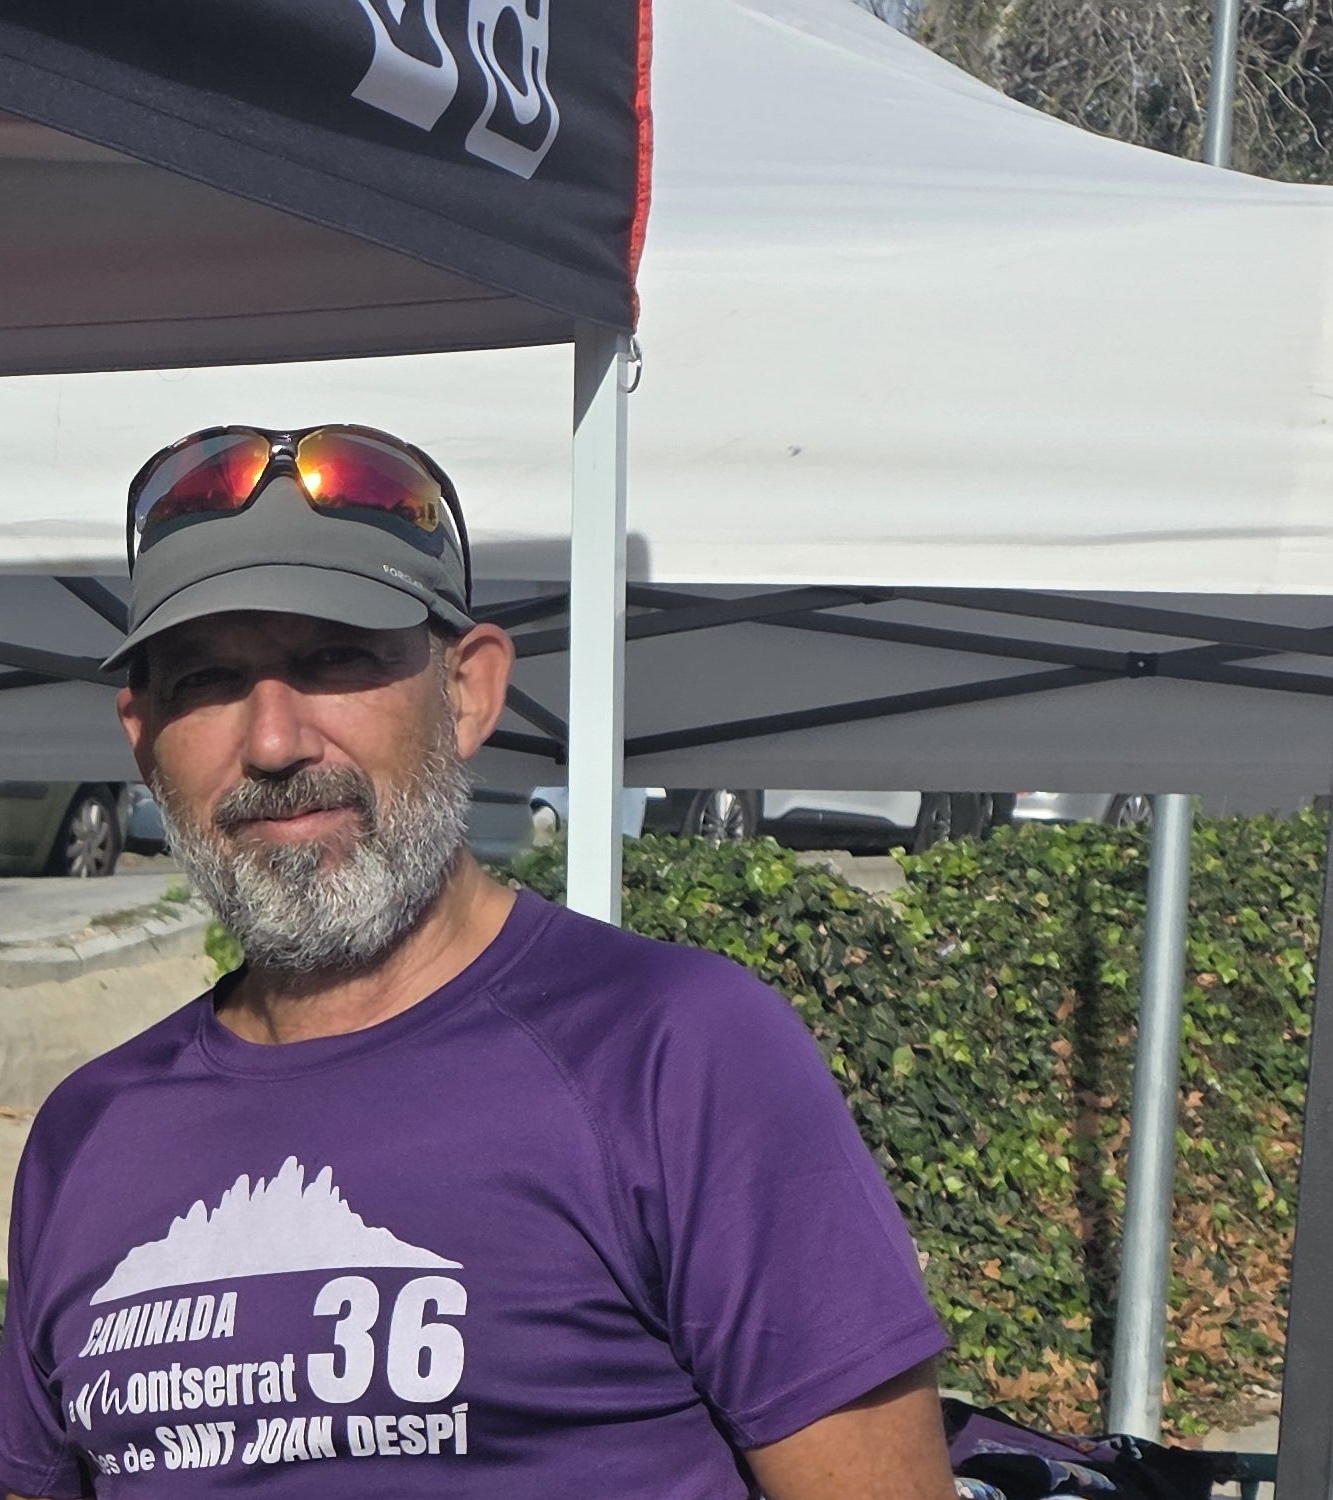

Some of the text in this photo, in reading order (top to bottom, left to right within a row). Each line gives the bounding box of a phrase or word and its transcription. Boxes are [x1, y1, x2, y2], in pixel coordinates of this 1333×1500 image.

[78, 1292, 237, 1358] CAMINADA
[307, 1276, 467, 1403] 36
[76, 1354, 296, 1430] Montserrat
[124, 1443, 155, 1473] de
[156, 1419, 235, 1470] SANT
[241, 1415, 334, 1464] JOAN
[348, 1402, 468, 1457] DESPÍ
